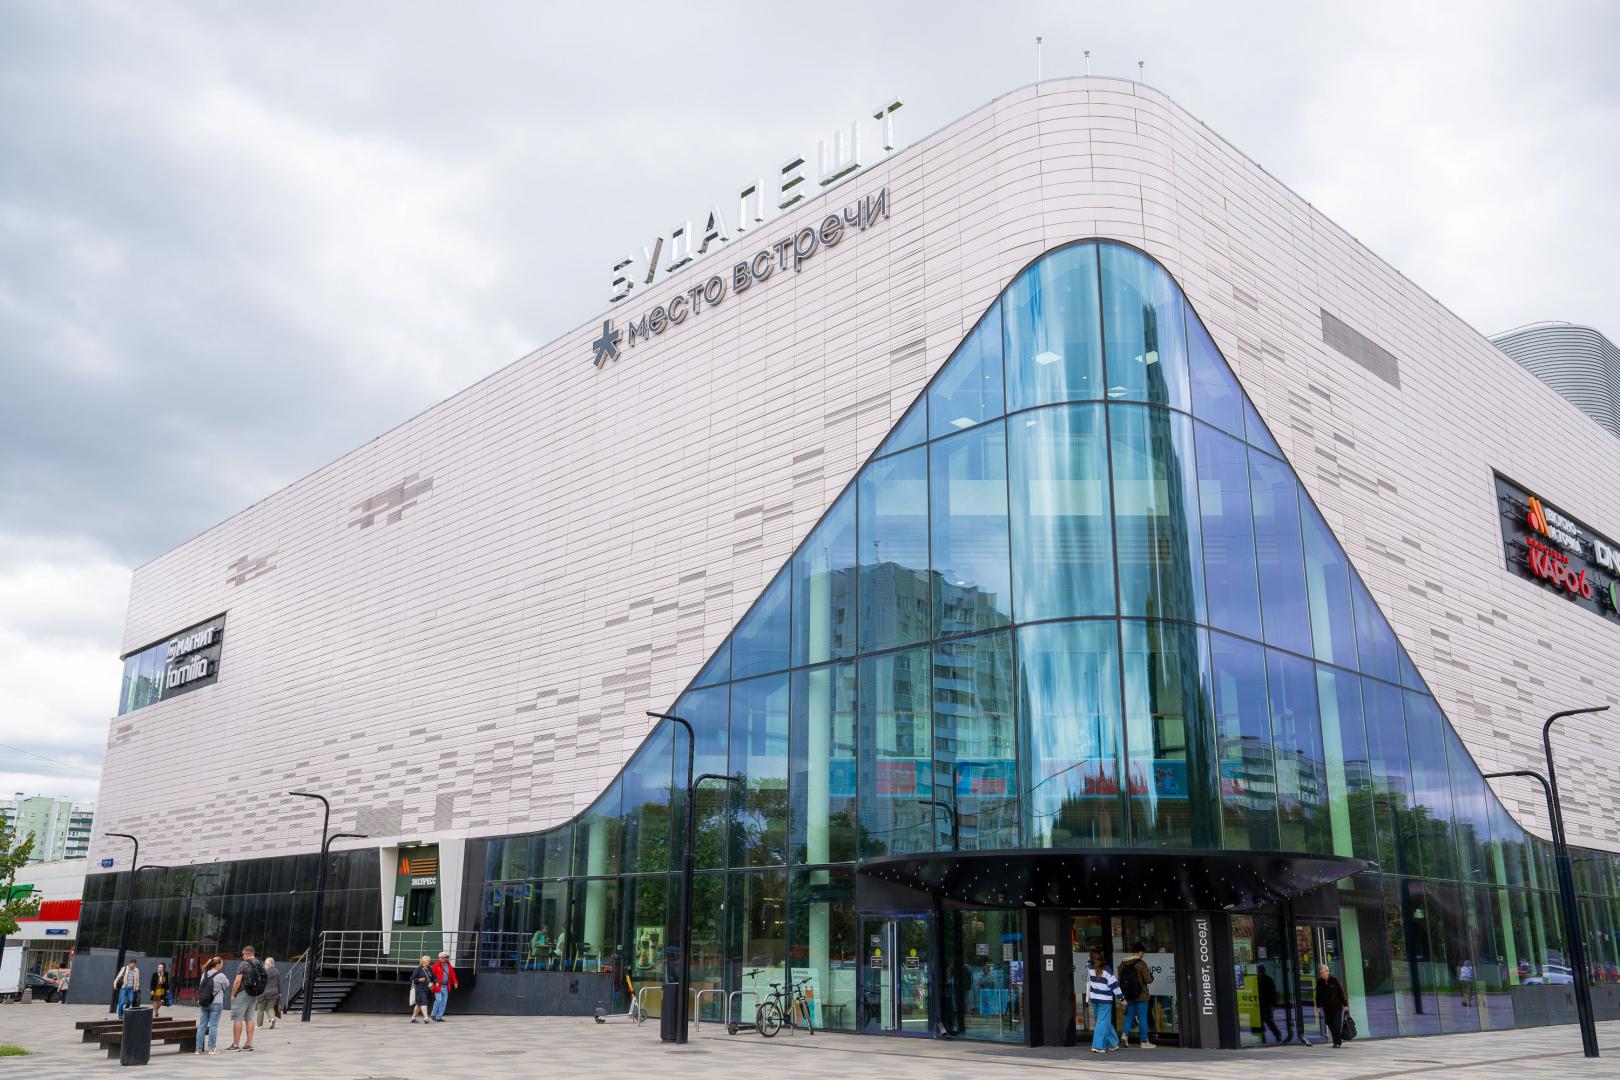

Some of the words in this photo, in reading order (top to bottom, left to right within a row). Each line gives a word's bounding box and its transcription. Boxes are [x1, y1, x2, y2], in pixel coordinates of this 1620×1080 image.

[607, 95, 904, 303] БУДАПЕШТ
[176, 626, 216, 657] МАГНИТ
[165, 655, 208, 689] familia
[411, 877, 437, 886] ЭКСПРЕСС
[1195, 918, 1209, 962] сосед!
[1201, 965, 1215, 1015] Привет,
